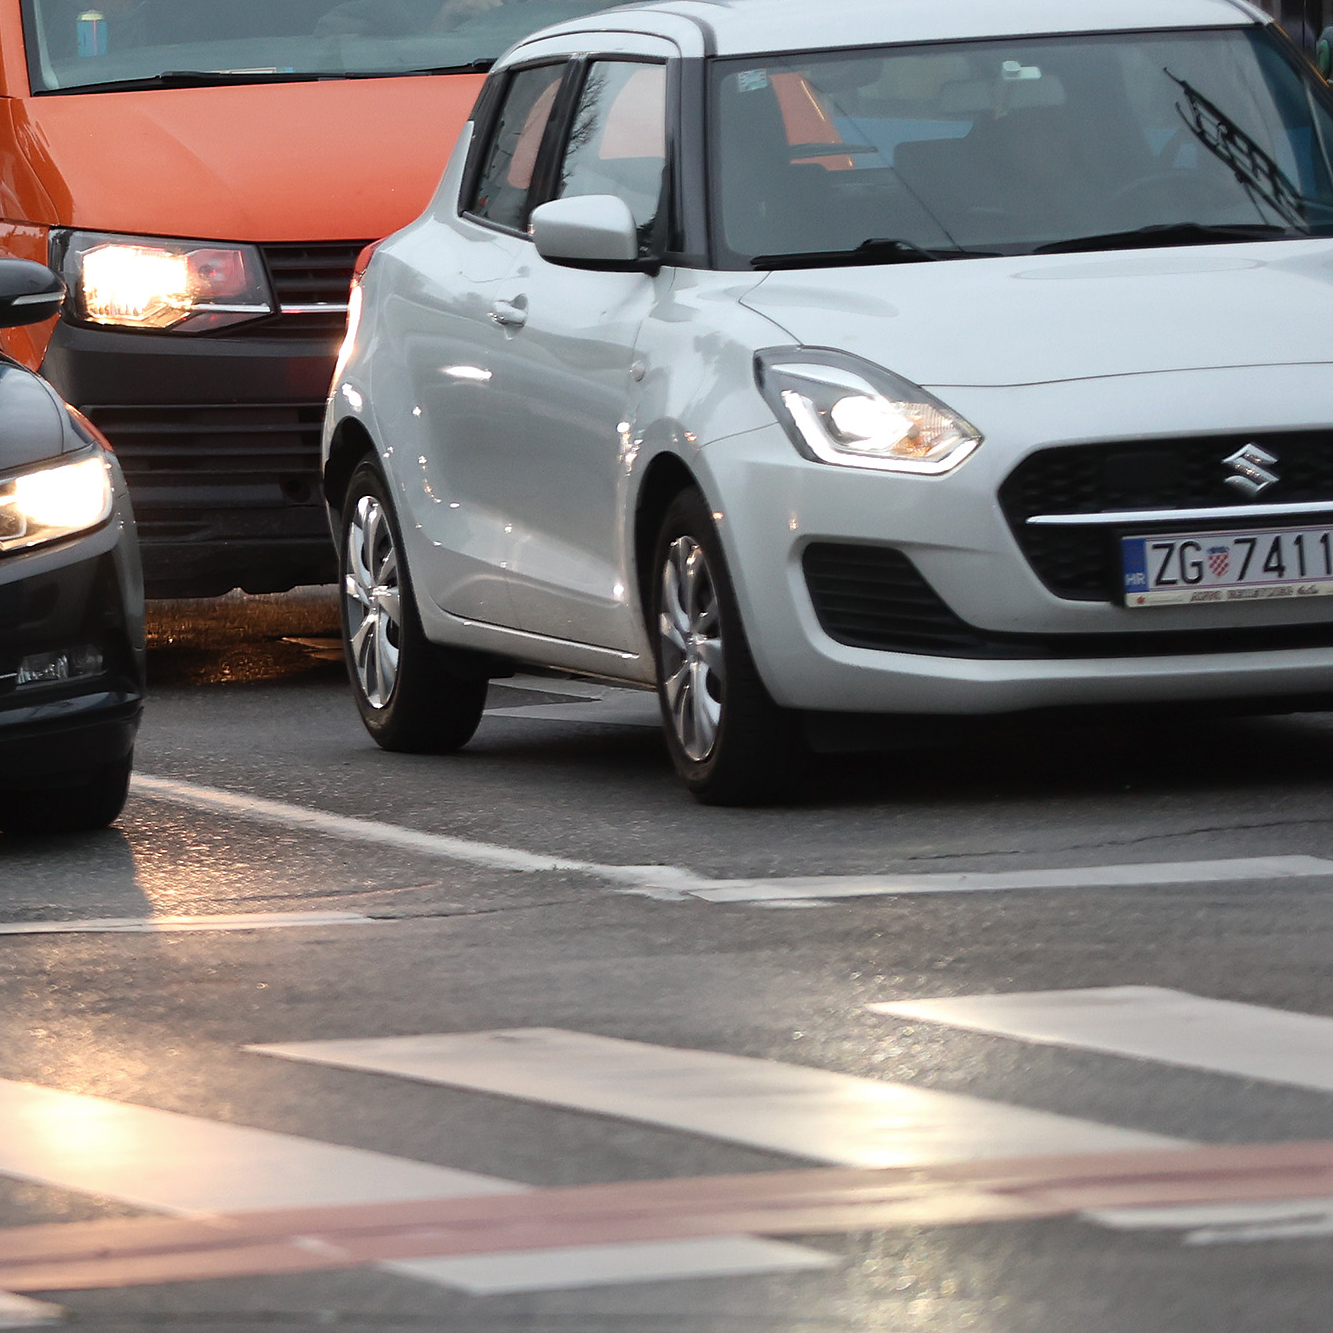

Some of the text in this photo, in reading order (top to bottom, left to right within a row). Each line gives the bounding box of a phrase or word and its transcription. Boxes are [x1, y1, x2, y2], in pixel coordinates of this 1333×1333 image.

[1151, 532, 1333, 586] ZG 7411
[1125, 572, 1146, 586] HR
